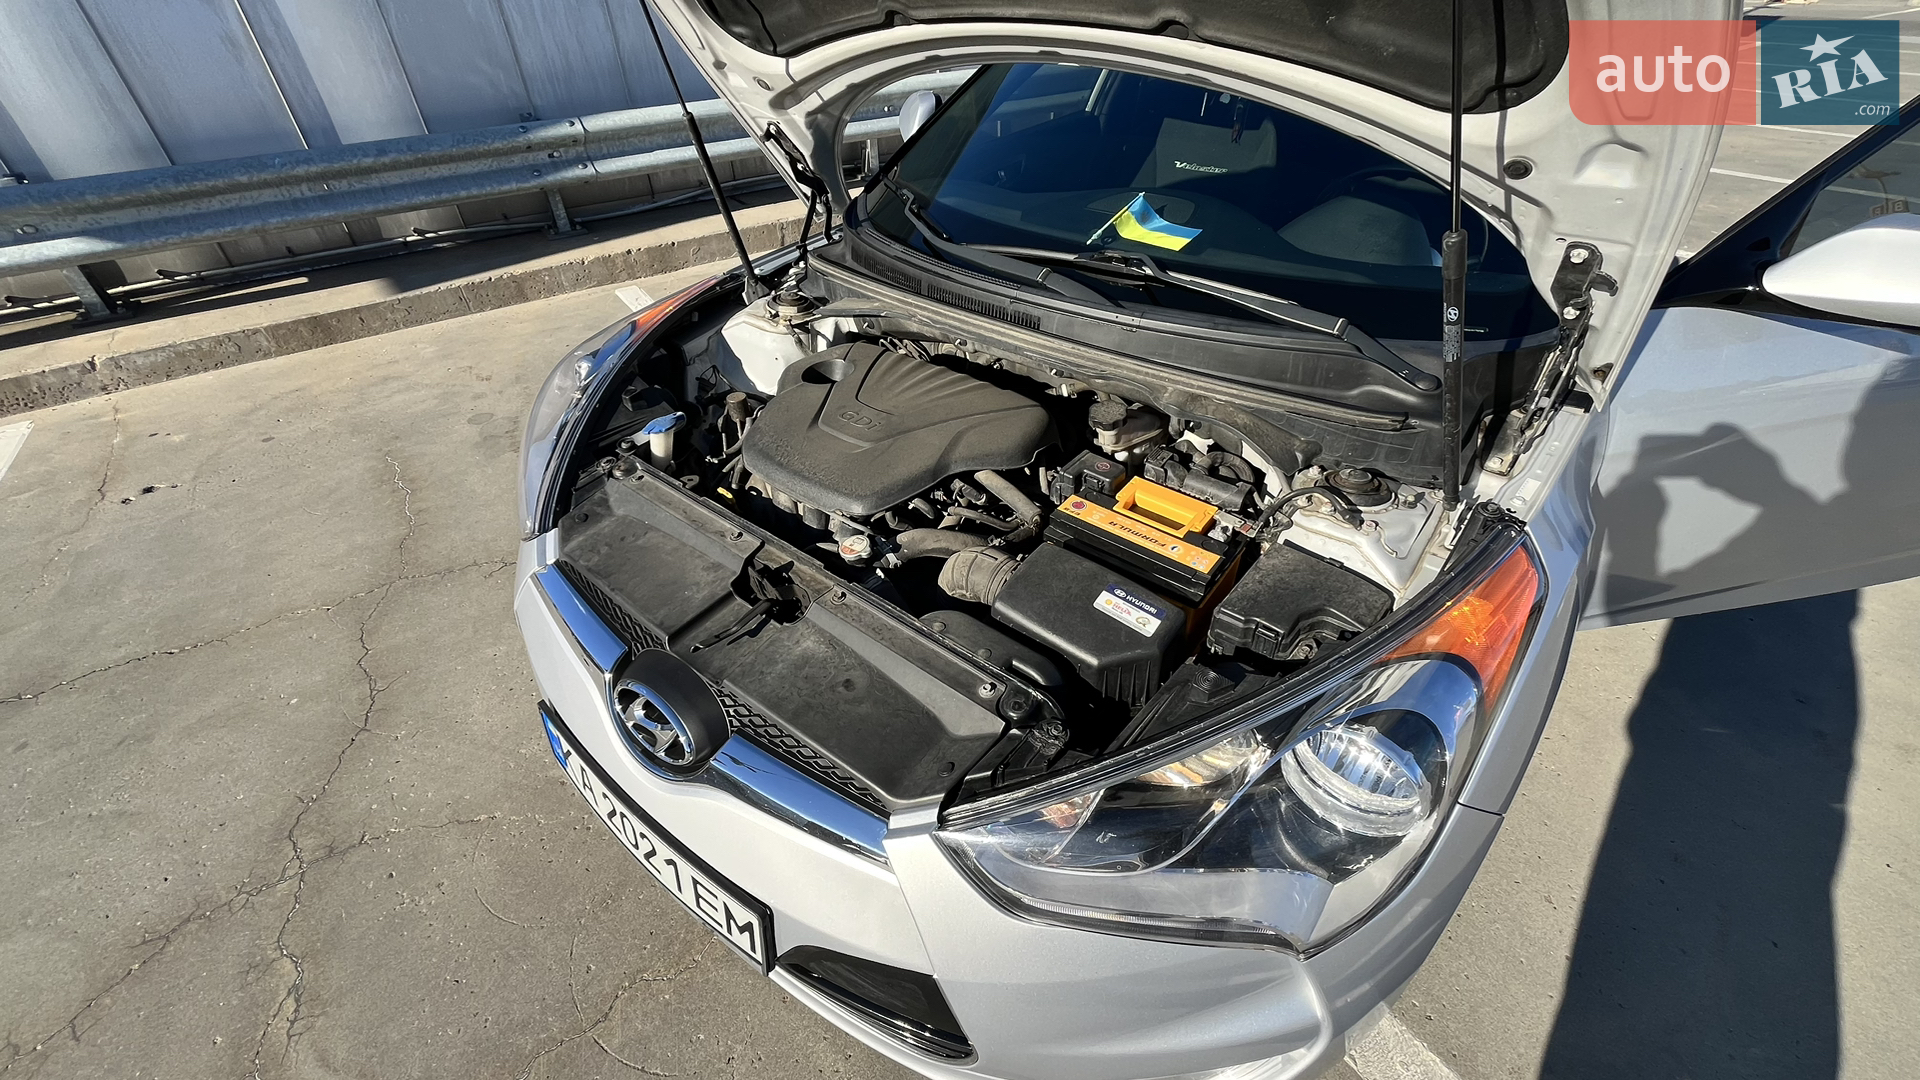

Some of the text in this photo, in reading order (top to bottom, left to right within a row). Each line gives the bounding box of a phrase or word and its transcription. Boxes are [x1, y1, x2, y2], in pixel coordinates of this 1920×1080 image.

[1108, 521, 1167, 547] FORMULA
[1126, 595, 1158, 615] HYUNDAI
[602, 791, 682, 895] 2021
[690, 875, 757, 955] EM
